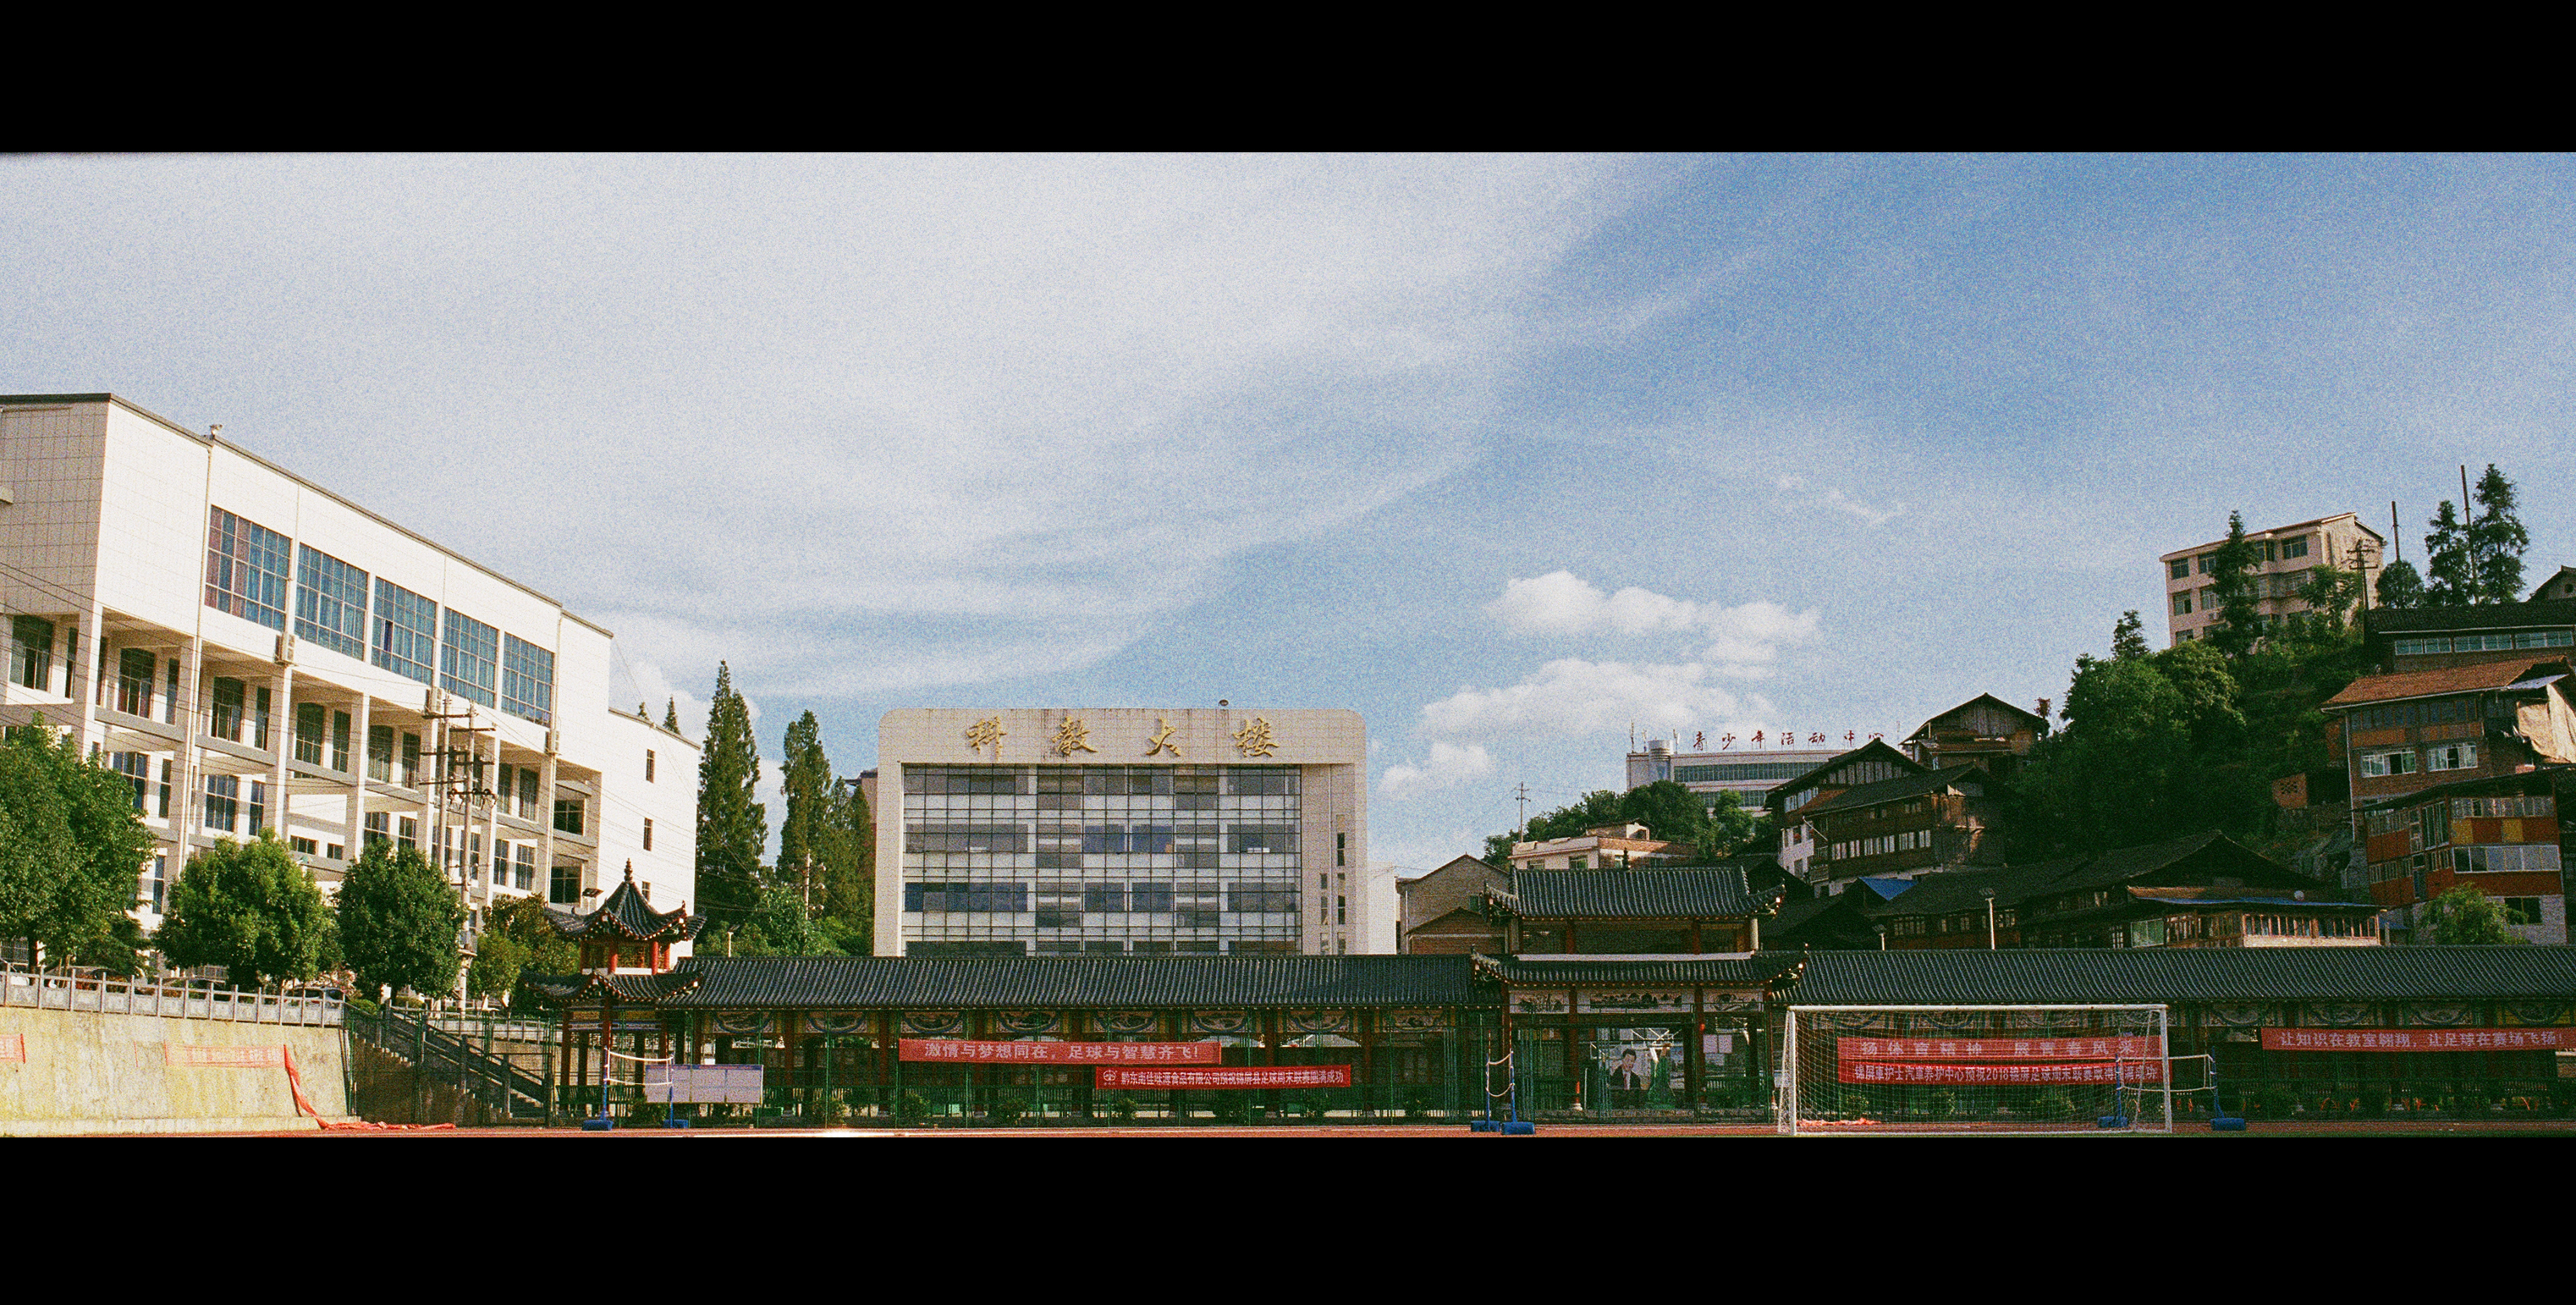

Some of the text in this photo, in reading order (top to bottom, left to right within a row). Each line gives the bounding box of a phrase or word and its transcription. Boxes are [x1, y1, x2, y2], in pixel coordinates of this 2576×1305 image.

[1693, 730, 1884, 751] 青少年活动中心
